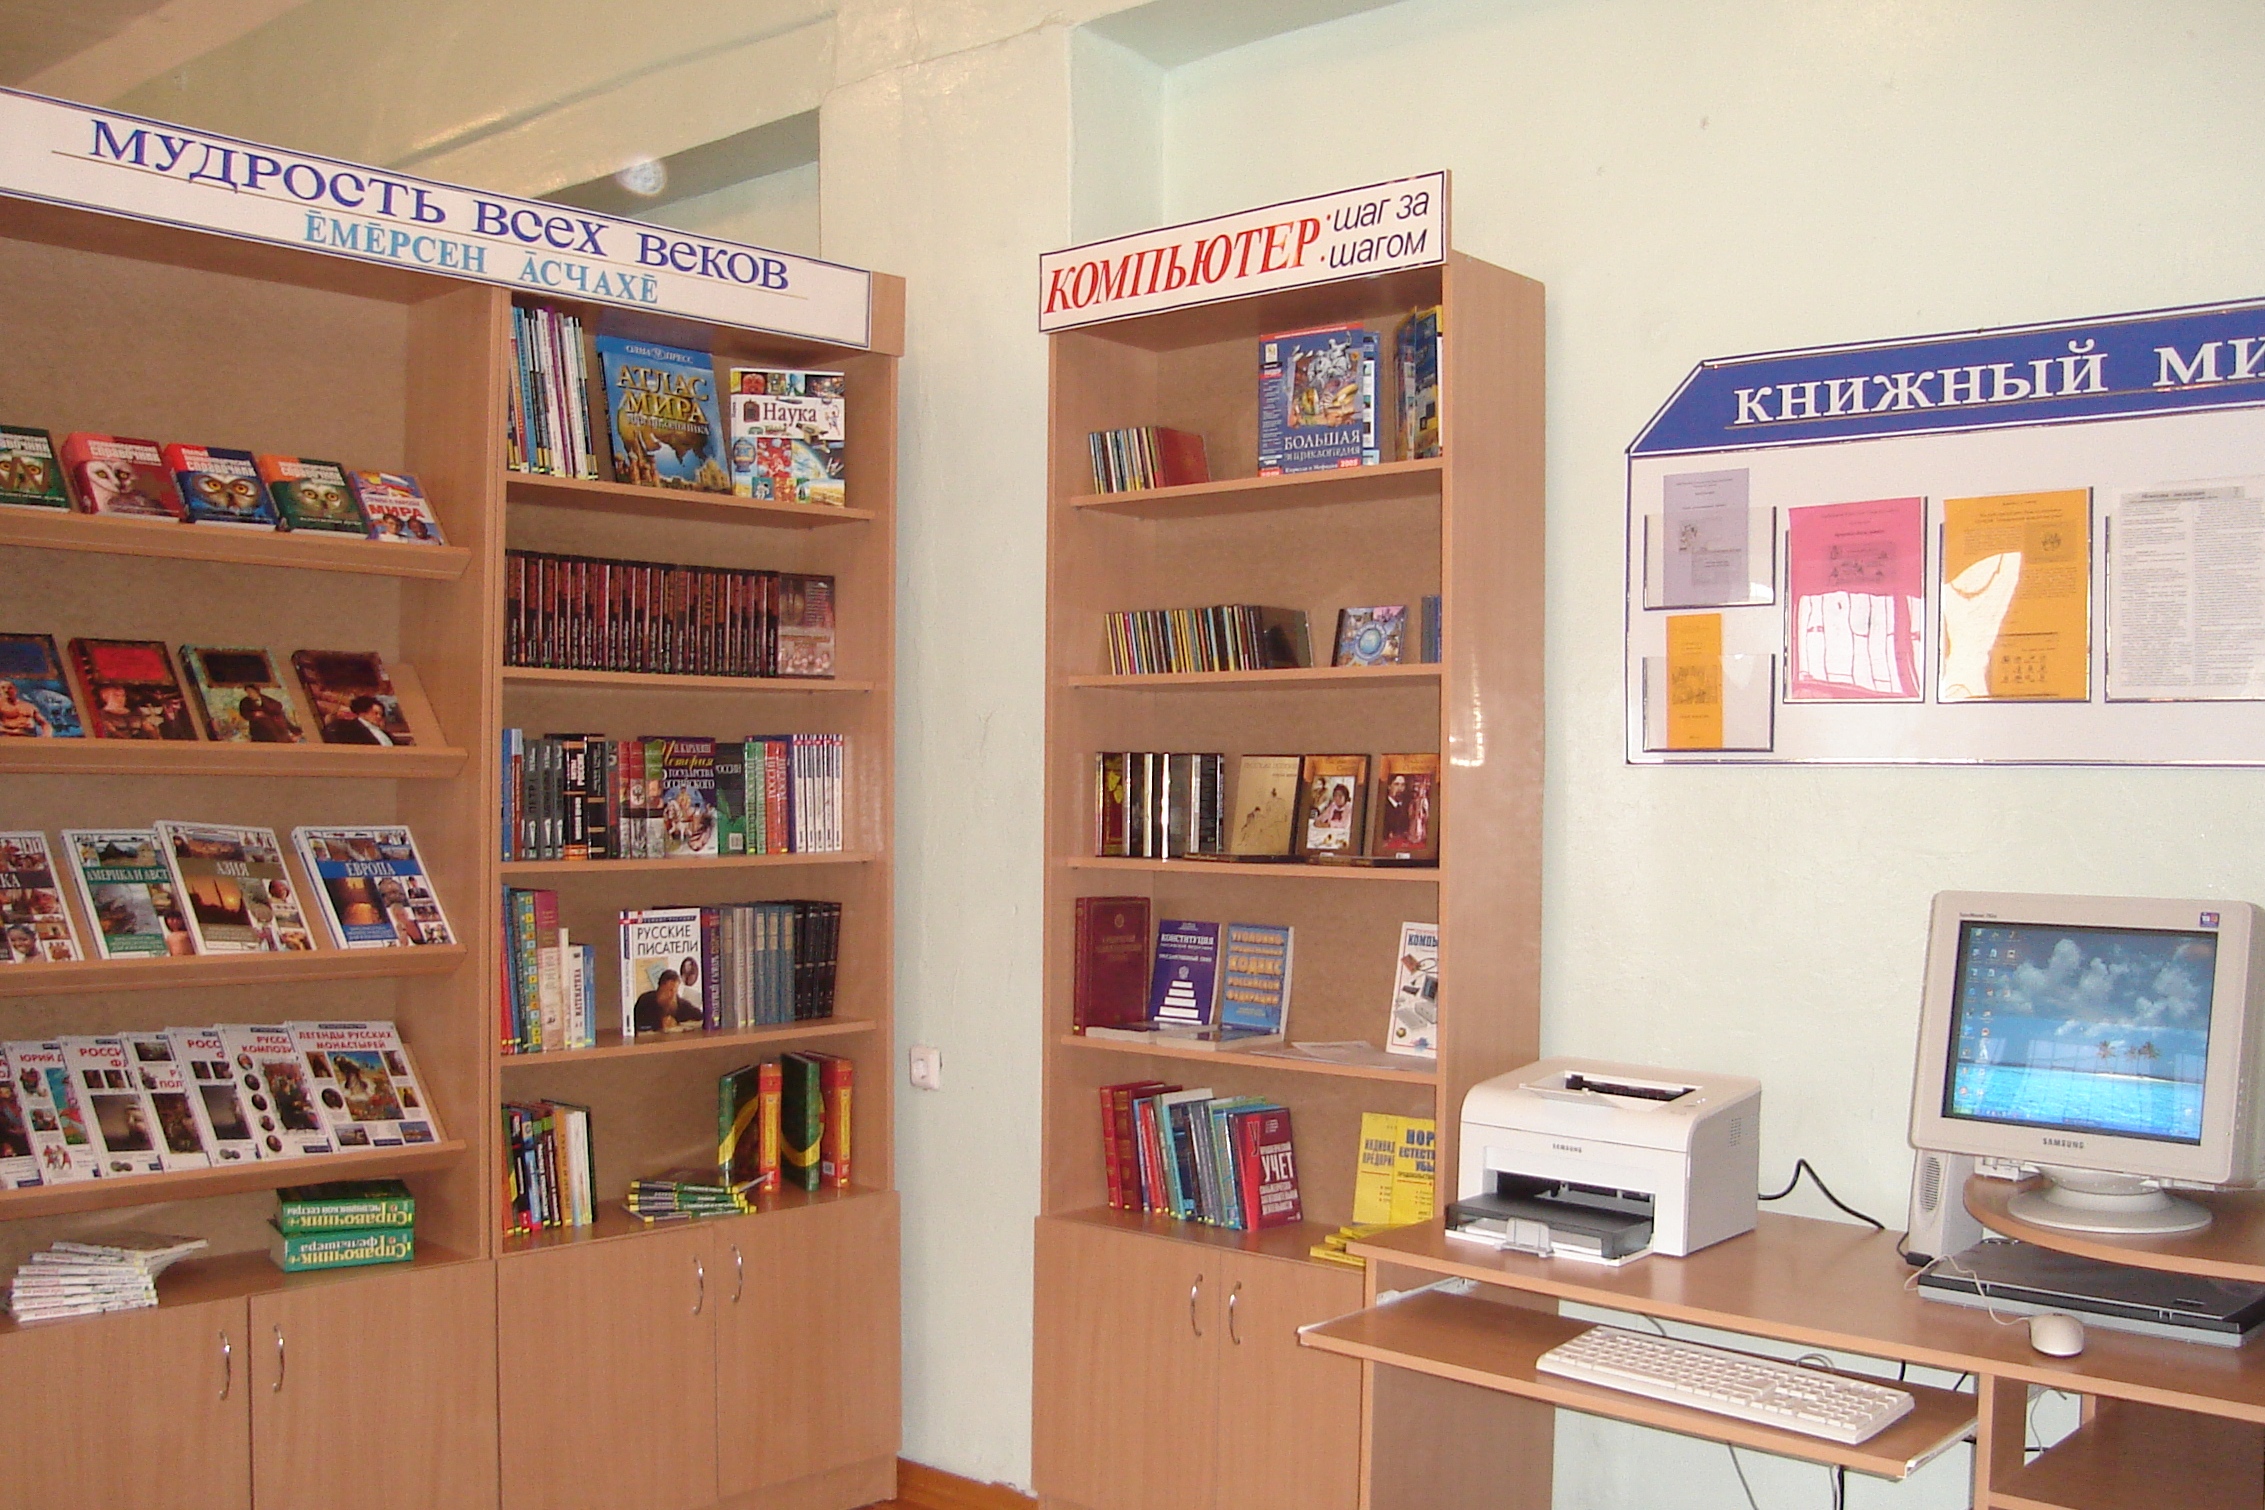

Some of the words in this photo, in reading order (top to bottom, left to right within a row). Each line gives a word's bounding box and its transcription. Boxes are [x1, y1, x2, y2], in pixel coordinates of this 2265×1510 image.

[89, 119, 446, 224] МУДРОСТЬ
[1333, 197, 1391, 232] шаг
[1395, 191, 1430, 217] за
[1328, 229, 1428, 270] шагом
[1043, 217, 1321, 315] КОМПЬЮТЕР
[615, 365, 709, 401] АТЛАС
[1733, 338, 2109, 425] КНИЖНЫЙ
[622, 390, 709, 424] МИРА
[762, 402, 817, 427] Наука
[1284, 430, 1361, 450] БОЛЬШАЯ
[368, 503, 426, 518] МИРА
[216, 861, 250, 877] АЗИЯ
[345, 861, 396, 877] ЕВРОПА
[637, 925, 691, 940] РУССКИЕ
[1161, 933, 1215, 945] КОНСТИТУЦИЯ
[637, 939, 699, 956] ПИСАТЕЛИ
[1228, 955, 1284, 975] КОДЕКС
[299, 1031, 344, 1040] ЛЕГЕНДЫ
[347, 1031, 393, 1039] РУССКИХ
[316, 1040, 386, 1049] МОНАСТЫРЕЙ
[2042, 1136, 2085, 1149] SAMSUNG
[1261, 1151, 1295, 1182] УЧЕТ
[300, 1235, 407, 1265] Справочник
